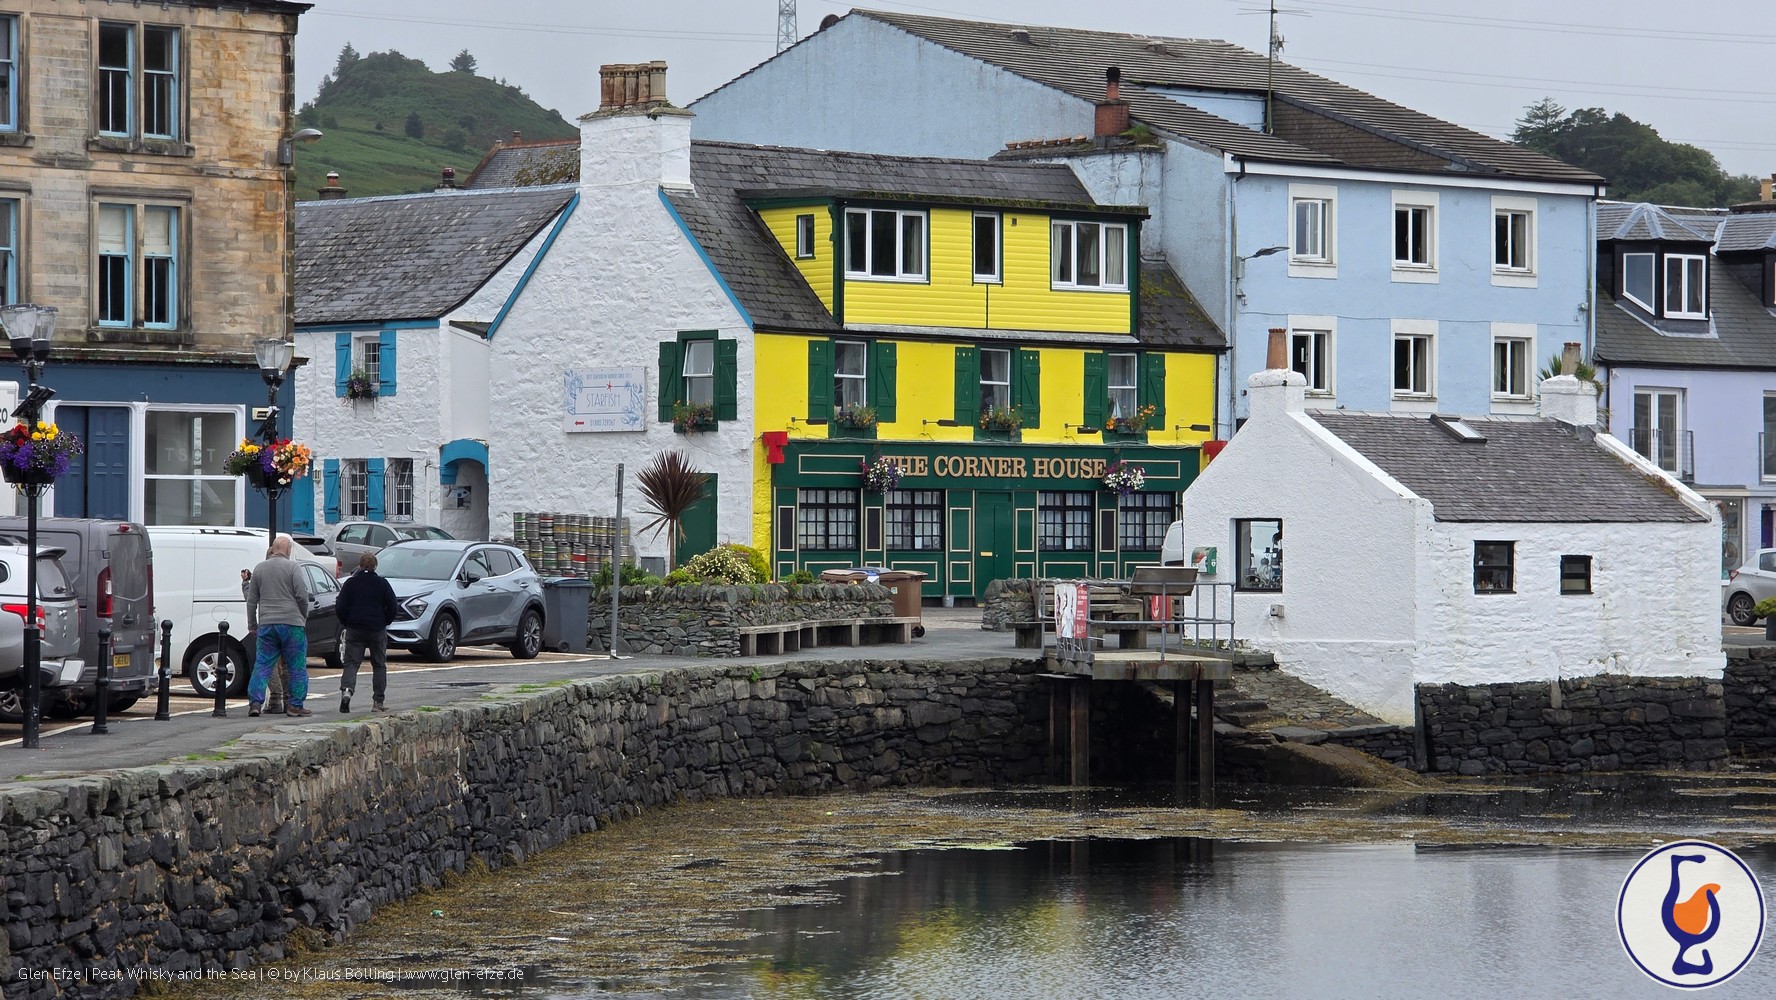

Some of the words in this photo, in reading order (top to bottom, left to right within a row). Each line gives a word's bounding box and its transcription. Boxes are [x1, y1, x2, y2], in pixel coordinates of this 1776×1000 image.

[586, 393, 620, 408] STARFISH
[934, 455, 1027, 478] CORNER
[1032, 457, 1107, 479] HOUSE
